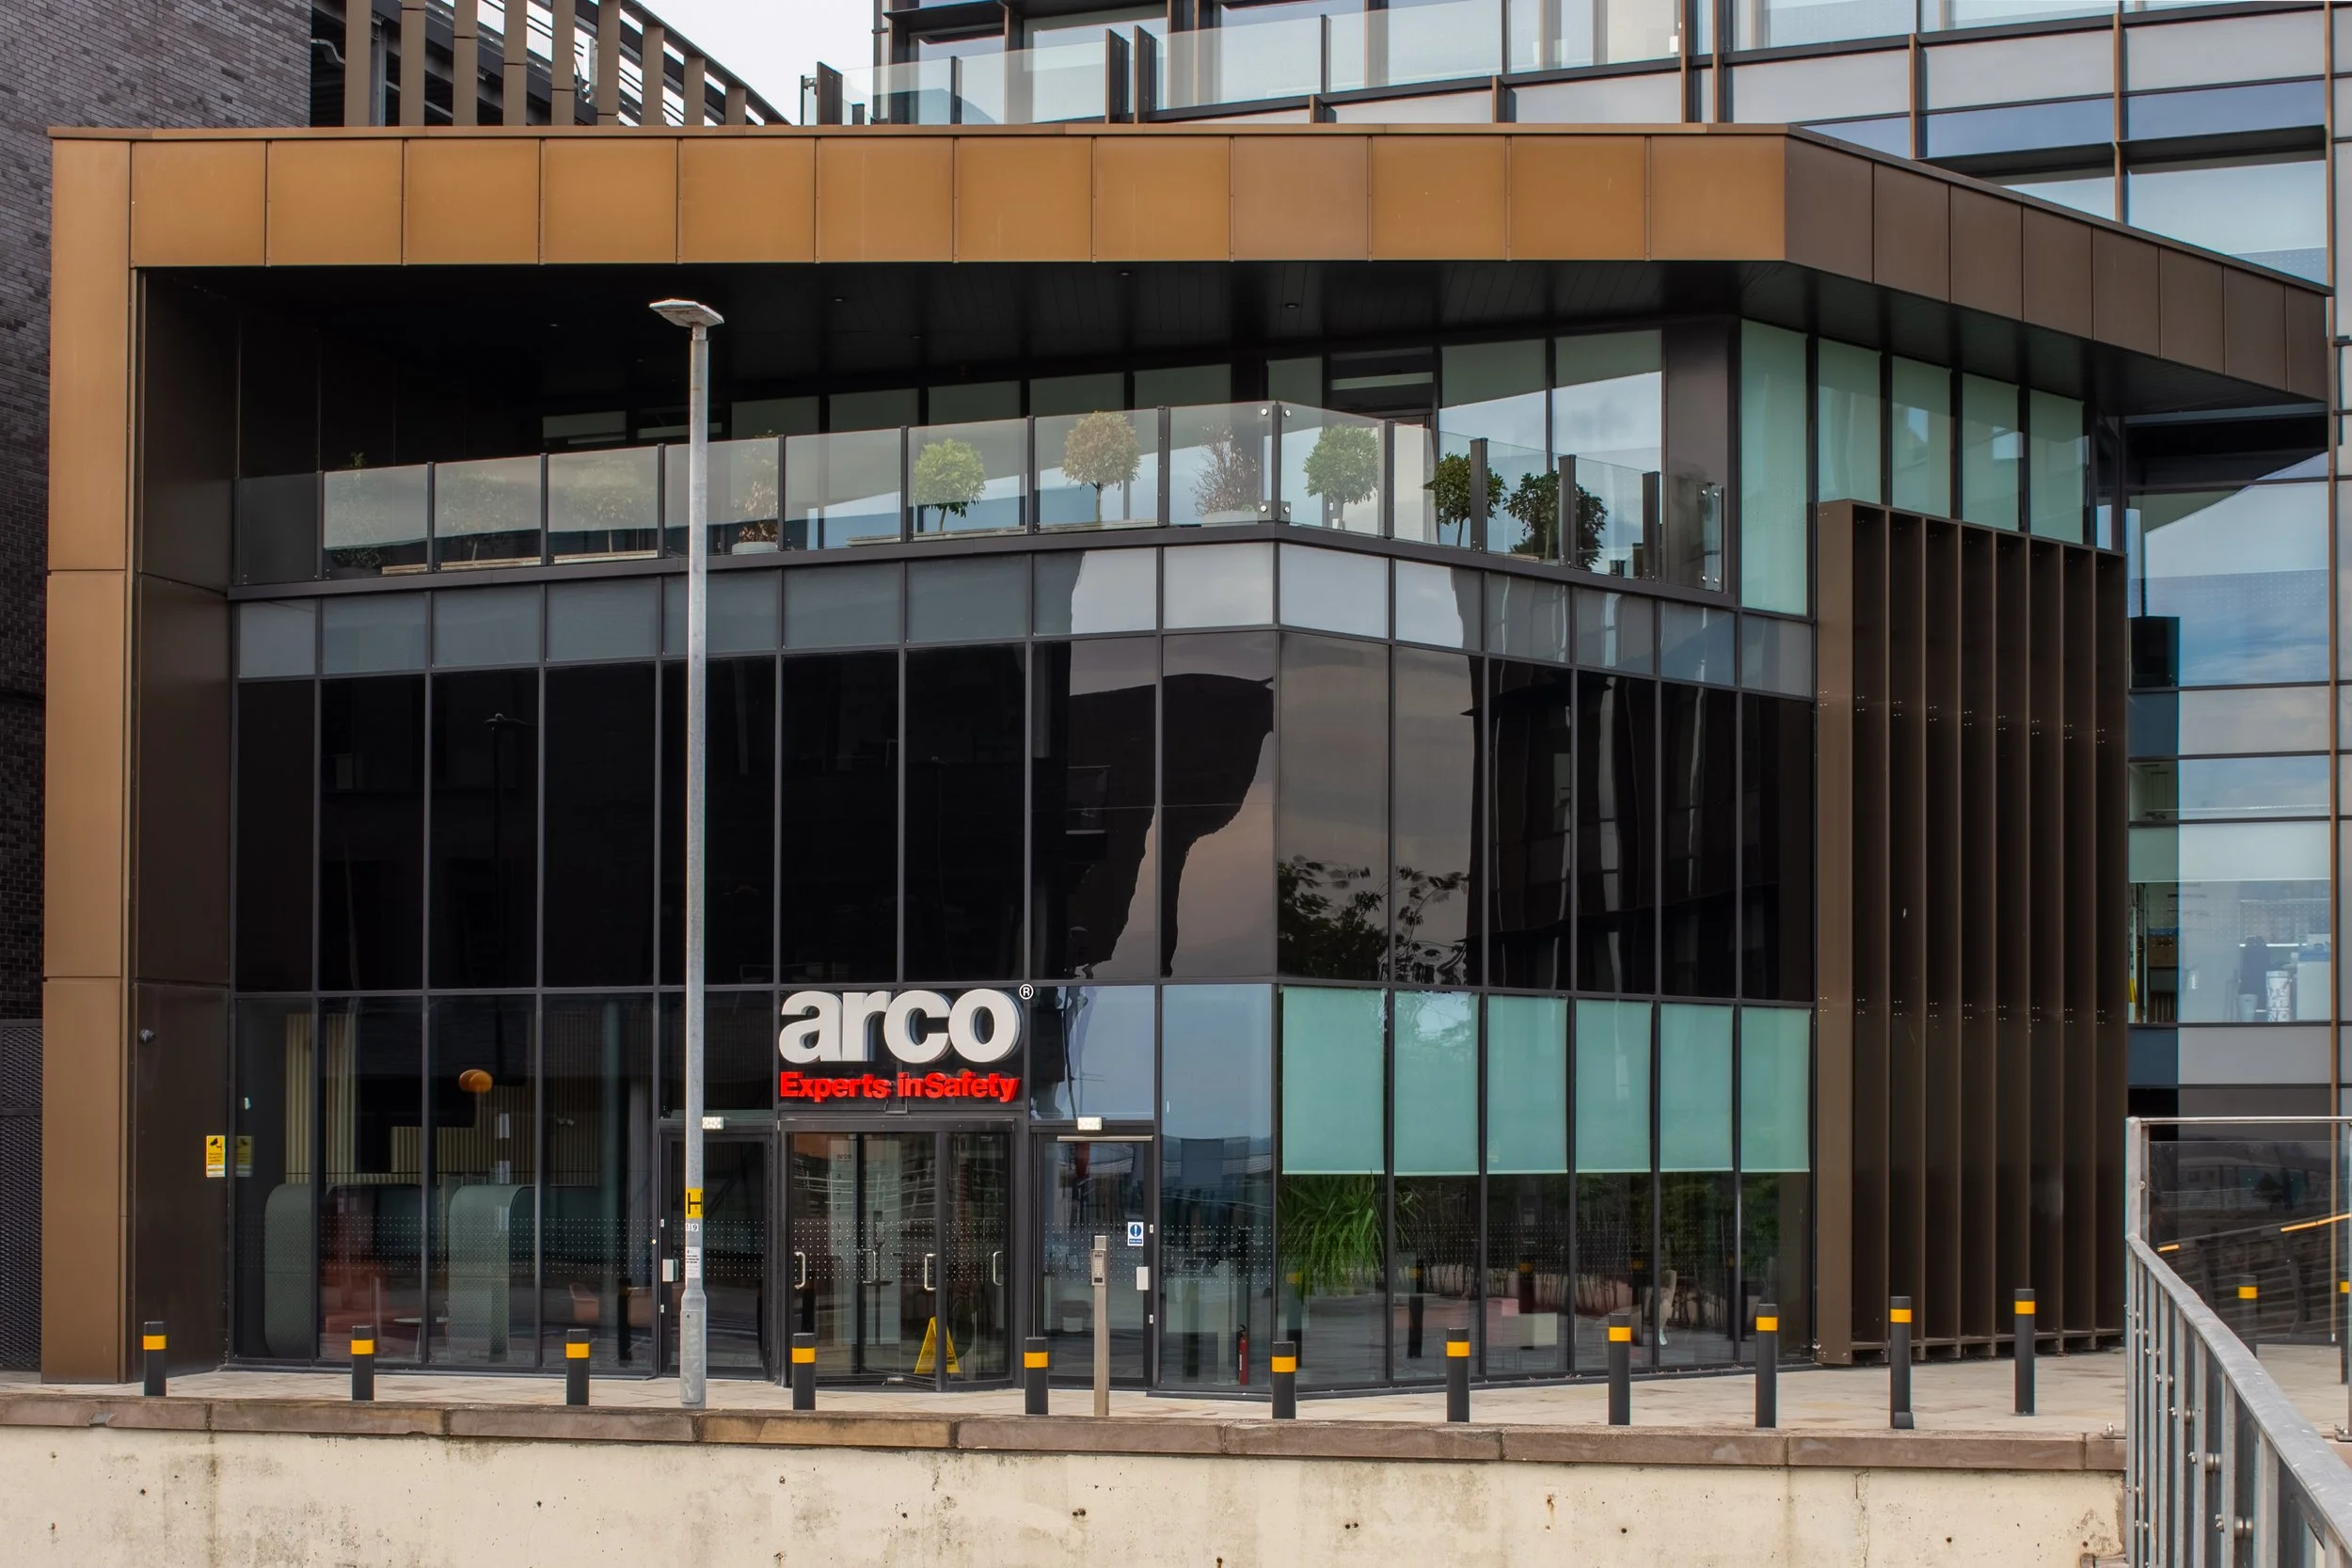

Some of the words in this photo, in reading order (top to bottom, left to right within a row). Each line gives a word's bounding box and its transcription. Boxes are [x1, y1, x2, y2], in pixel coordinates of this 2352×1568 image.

[779, 989, 1022, 1064] arco
[780, 1071, 892, 1102] Experts
[688, 1193, 703, 1214] H
